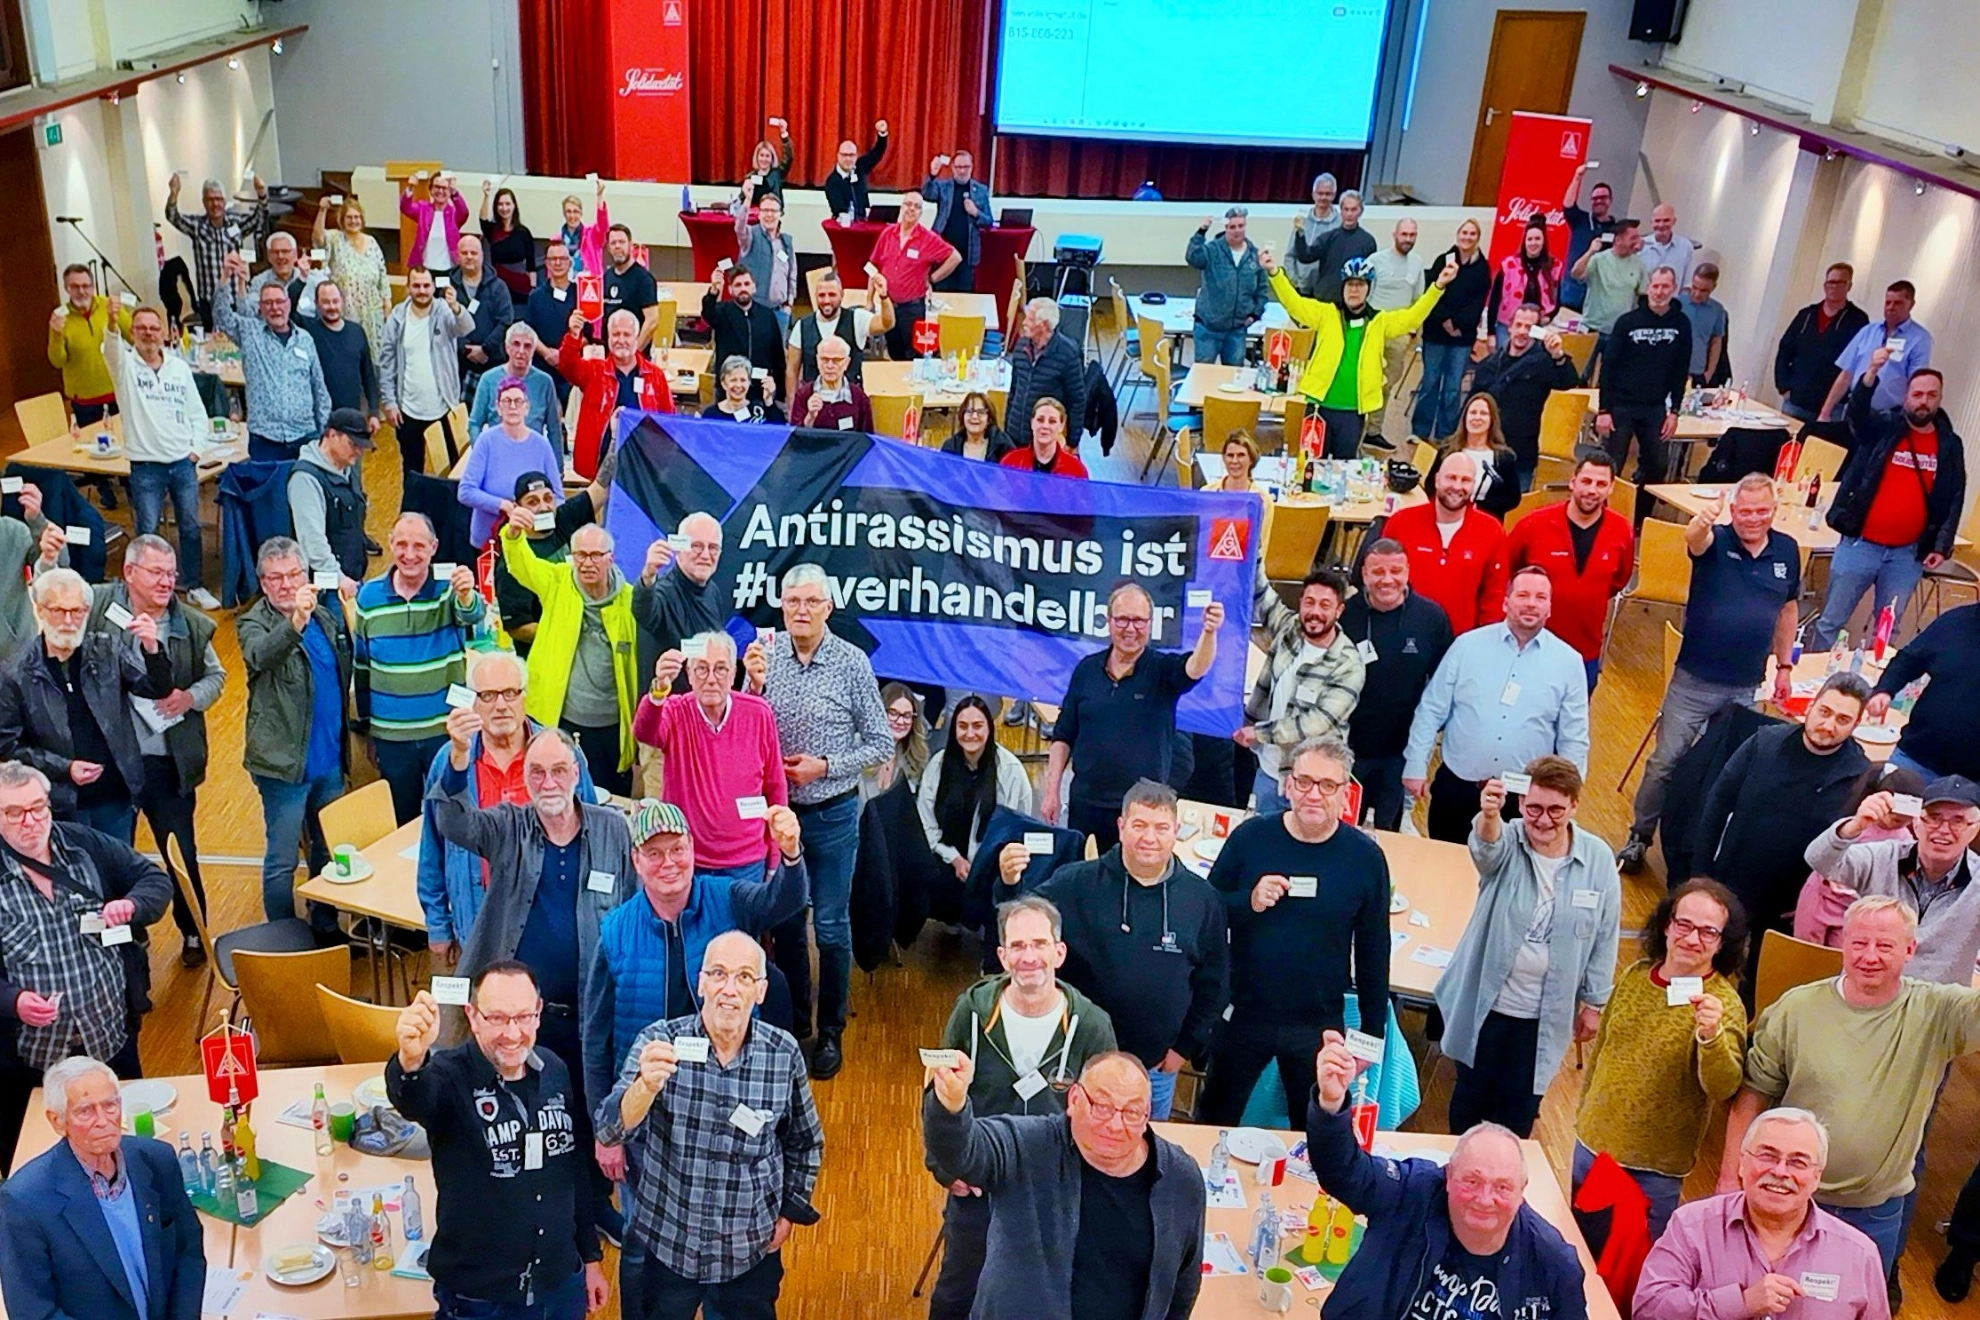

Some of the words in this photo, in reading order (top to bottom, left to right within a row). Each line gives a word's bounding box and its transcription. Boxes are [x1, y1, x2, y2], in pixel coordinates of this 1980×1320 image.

[739, 498, 1104, 576] Antirassismus
[1120, 528, 1188, 577] ist
[732, 561, 1176, 641] #uverhandelbr
[1349, 1033, 1380, 1049] Respekt!
[483, 1119, 521, 1149] AMP
[491, 1147, 521, 1162] EST.
[1804, 1276, 1836, 1286] Respekt!
